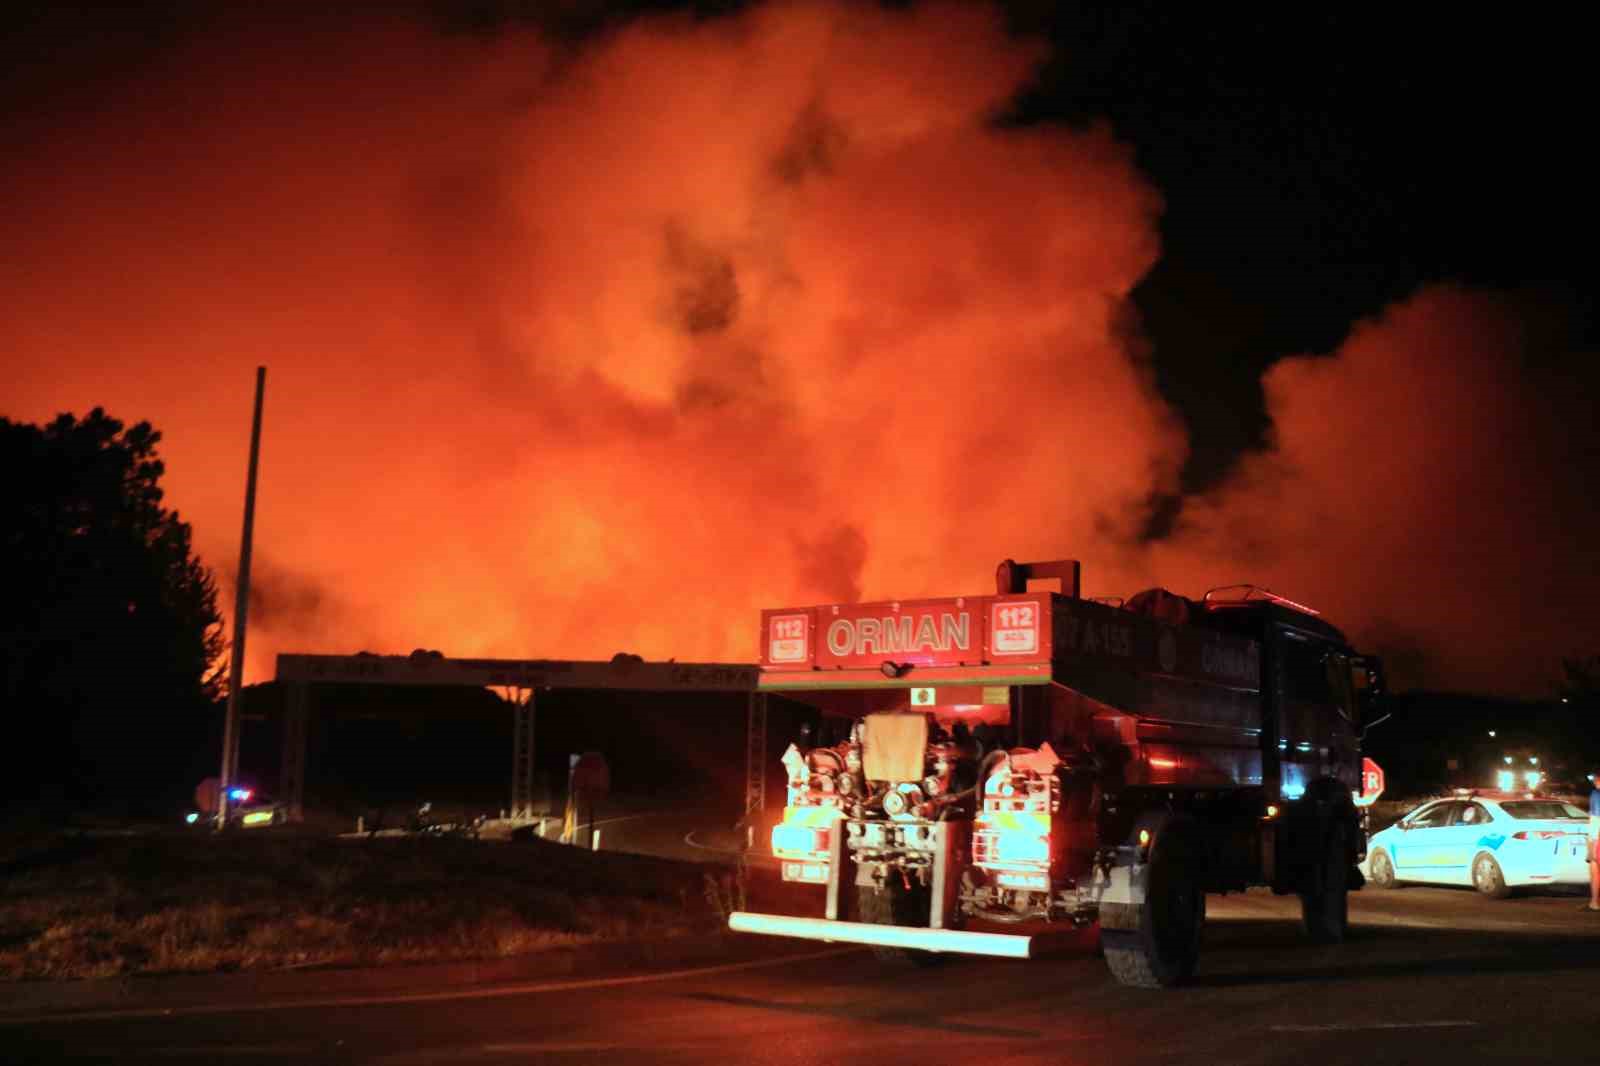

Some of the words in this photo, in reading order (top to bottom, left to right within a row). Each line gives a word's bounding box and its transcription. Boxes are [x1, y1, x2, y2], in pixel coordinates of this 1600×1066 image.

[999, 607, 1033, 628] 112
[776, 620, 803, 640] 112
[828, 613, 969, 656] ORMAN
